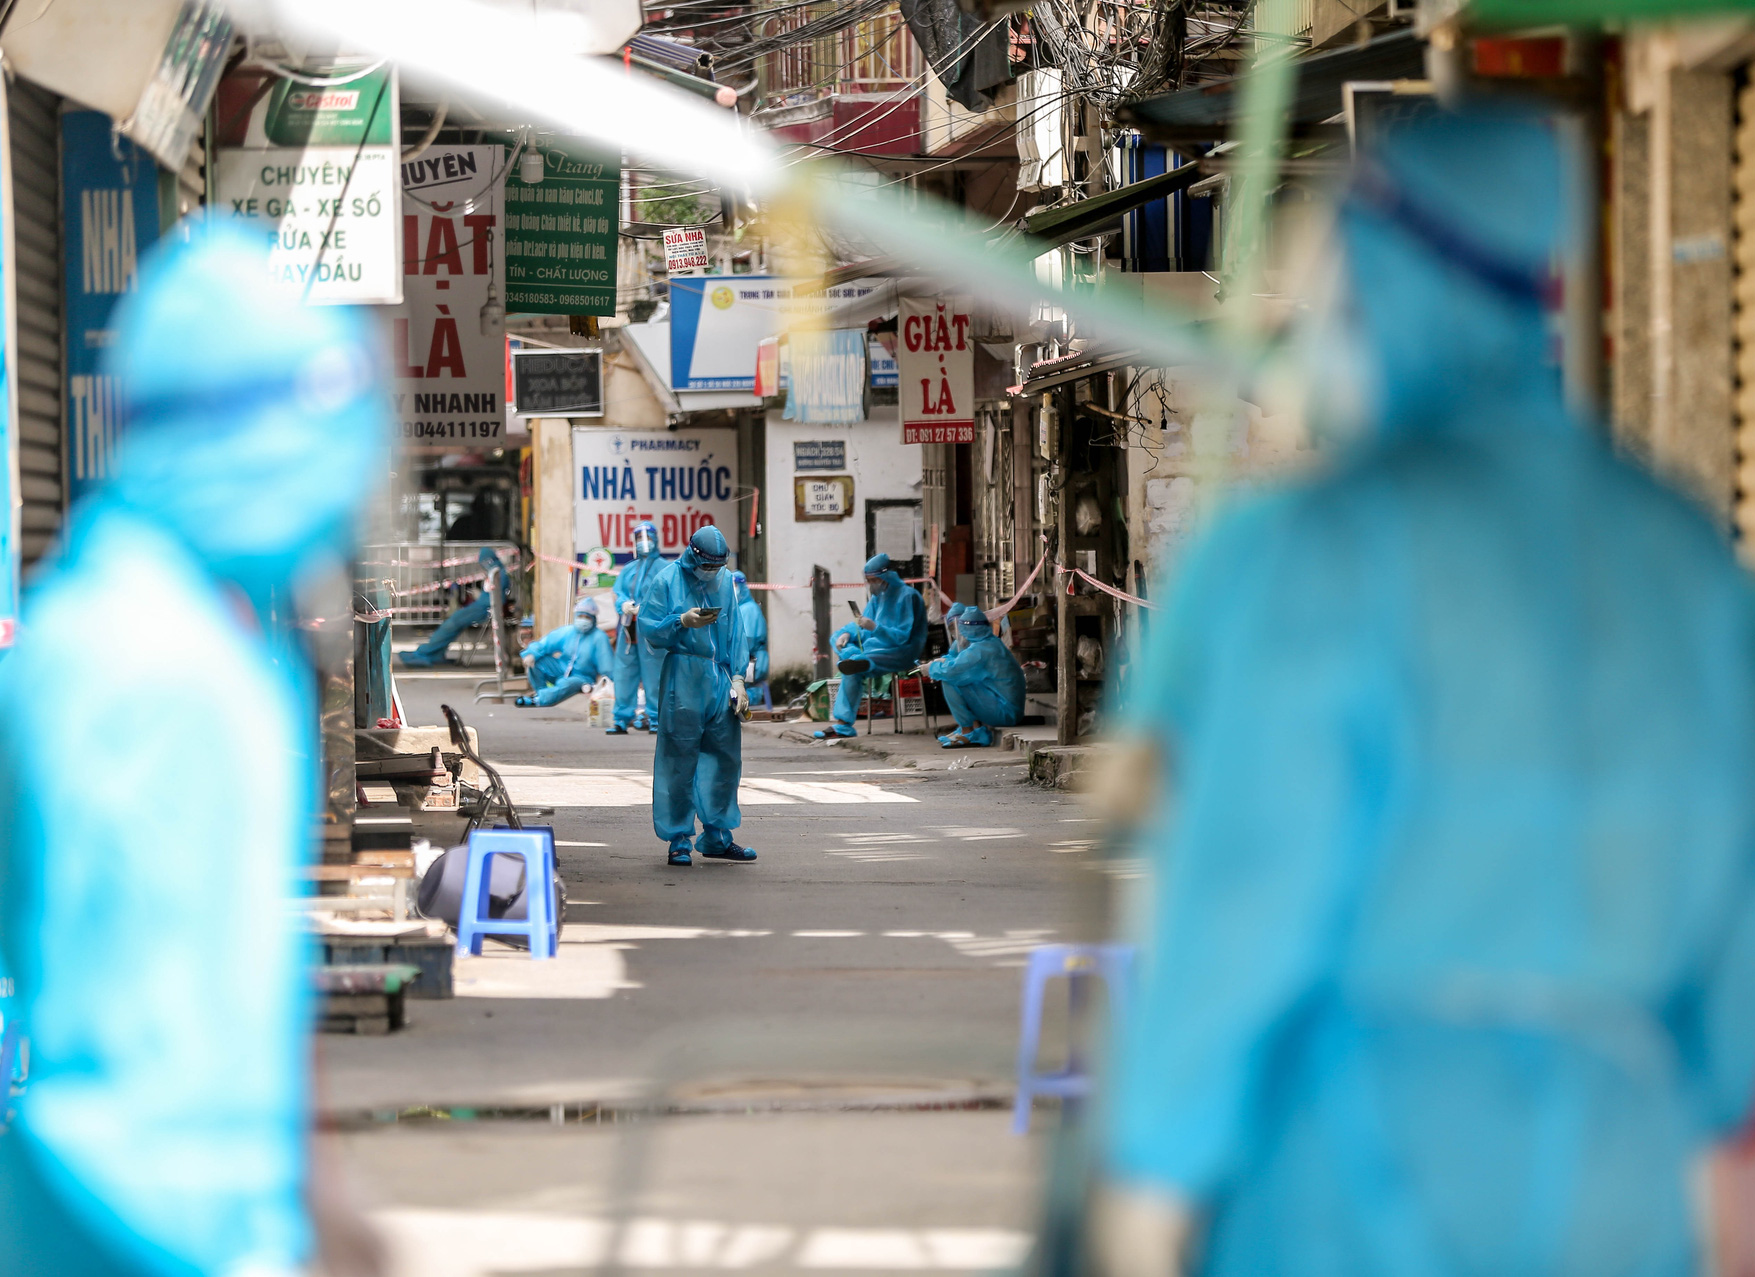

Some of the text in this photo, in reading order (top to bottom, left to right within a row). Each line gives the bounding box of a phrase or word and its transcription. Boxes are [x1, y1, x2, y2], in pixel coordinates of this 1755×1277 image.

[304, 93, 353, 109] Castrol
[261, 161, 351, 186] CHUYÊN
[546, 149, 604, 180] Trang
[231, 198, 259, 219] XE
[266, 198, 297, 218] GA
[318, 199, 345, 217] XE
[352, 190, 382, 218] SỐ
[536, 187, 544, 203] áo
[545, 188, 558, 203] nam
[82, 165, 139, 294] NHÀ
[521, 211, 540, 232] Quảng
[541, 213, 556, 231] Châu
[558, 212, 572, 232] thiết
[268, 223, 347, 250] RỬA XE
[403, 201, 496, 290] IẶT
[665, 231, 683, 245] SỬA
[684, 228, 704, 242] NHÀ
[549, 241, 556, 258] và
[570, 242, 583, 262] kiện
[668, 255, 708, 270] 0913.948.222
[318, 254, 363, 282] DẦU
[509, 264, 526, 278] TÍN
[537, 264, 567, 279] CHẤT
[569, 268, 609, 283] LƯỢNG
[560, 293, 610, 306] 0968501617
[393, 304, 467, 378] LÀ
[904, 303, 970, 363] GIẶT
[921, 367, 956, 415] LÀ
[414, 393, 496, 414] NHANH
[631, 439, 701, 451] PHARMACY
[920, 428, 934, 442] 091
[935, 428, 945, 442] 27
[947, 428, 957, 441] 57
[958, 427, 973, 441] 336
[582, 453, 731, 501] NHÀ THUỐC
